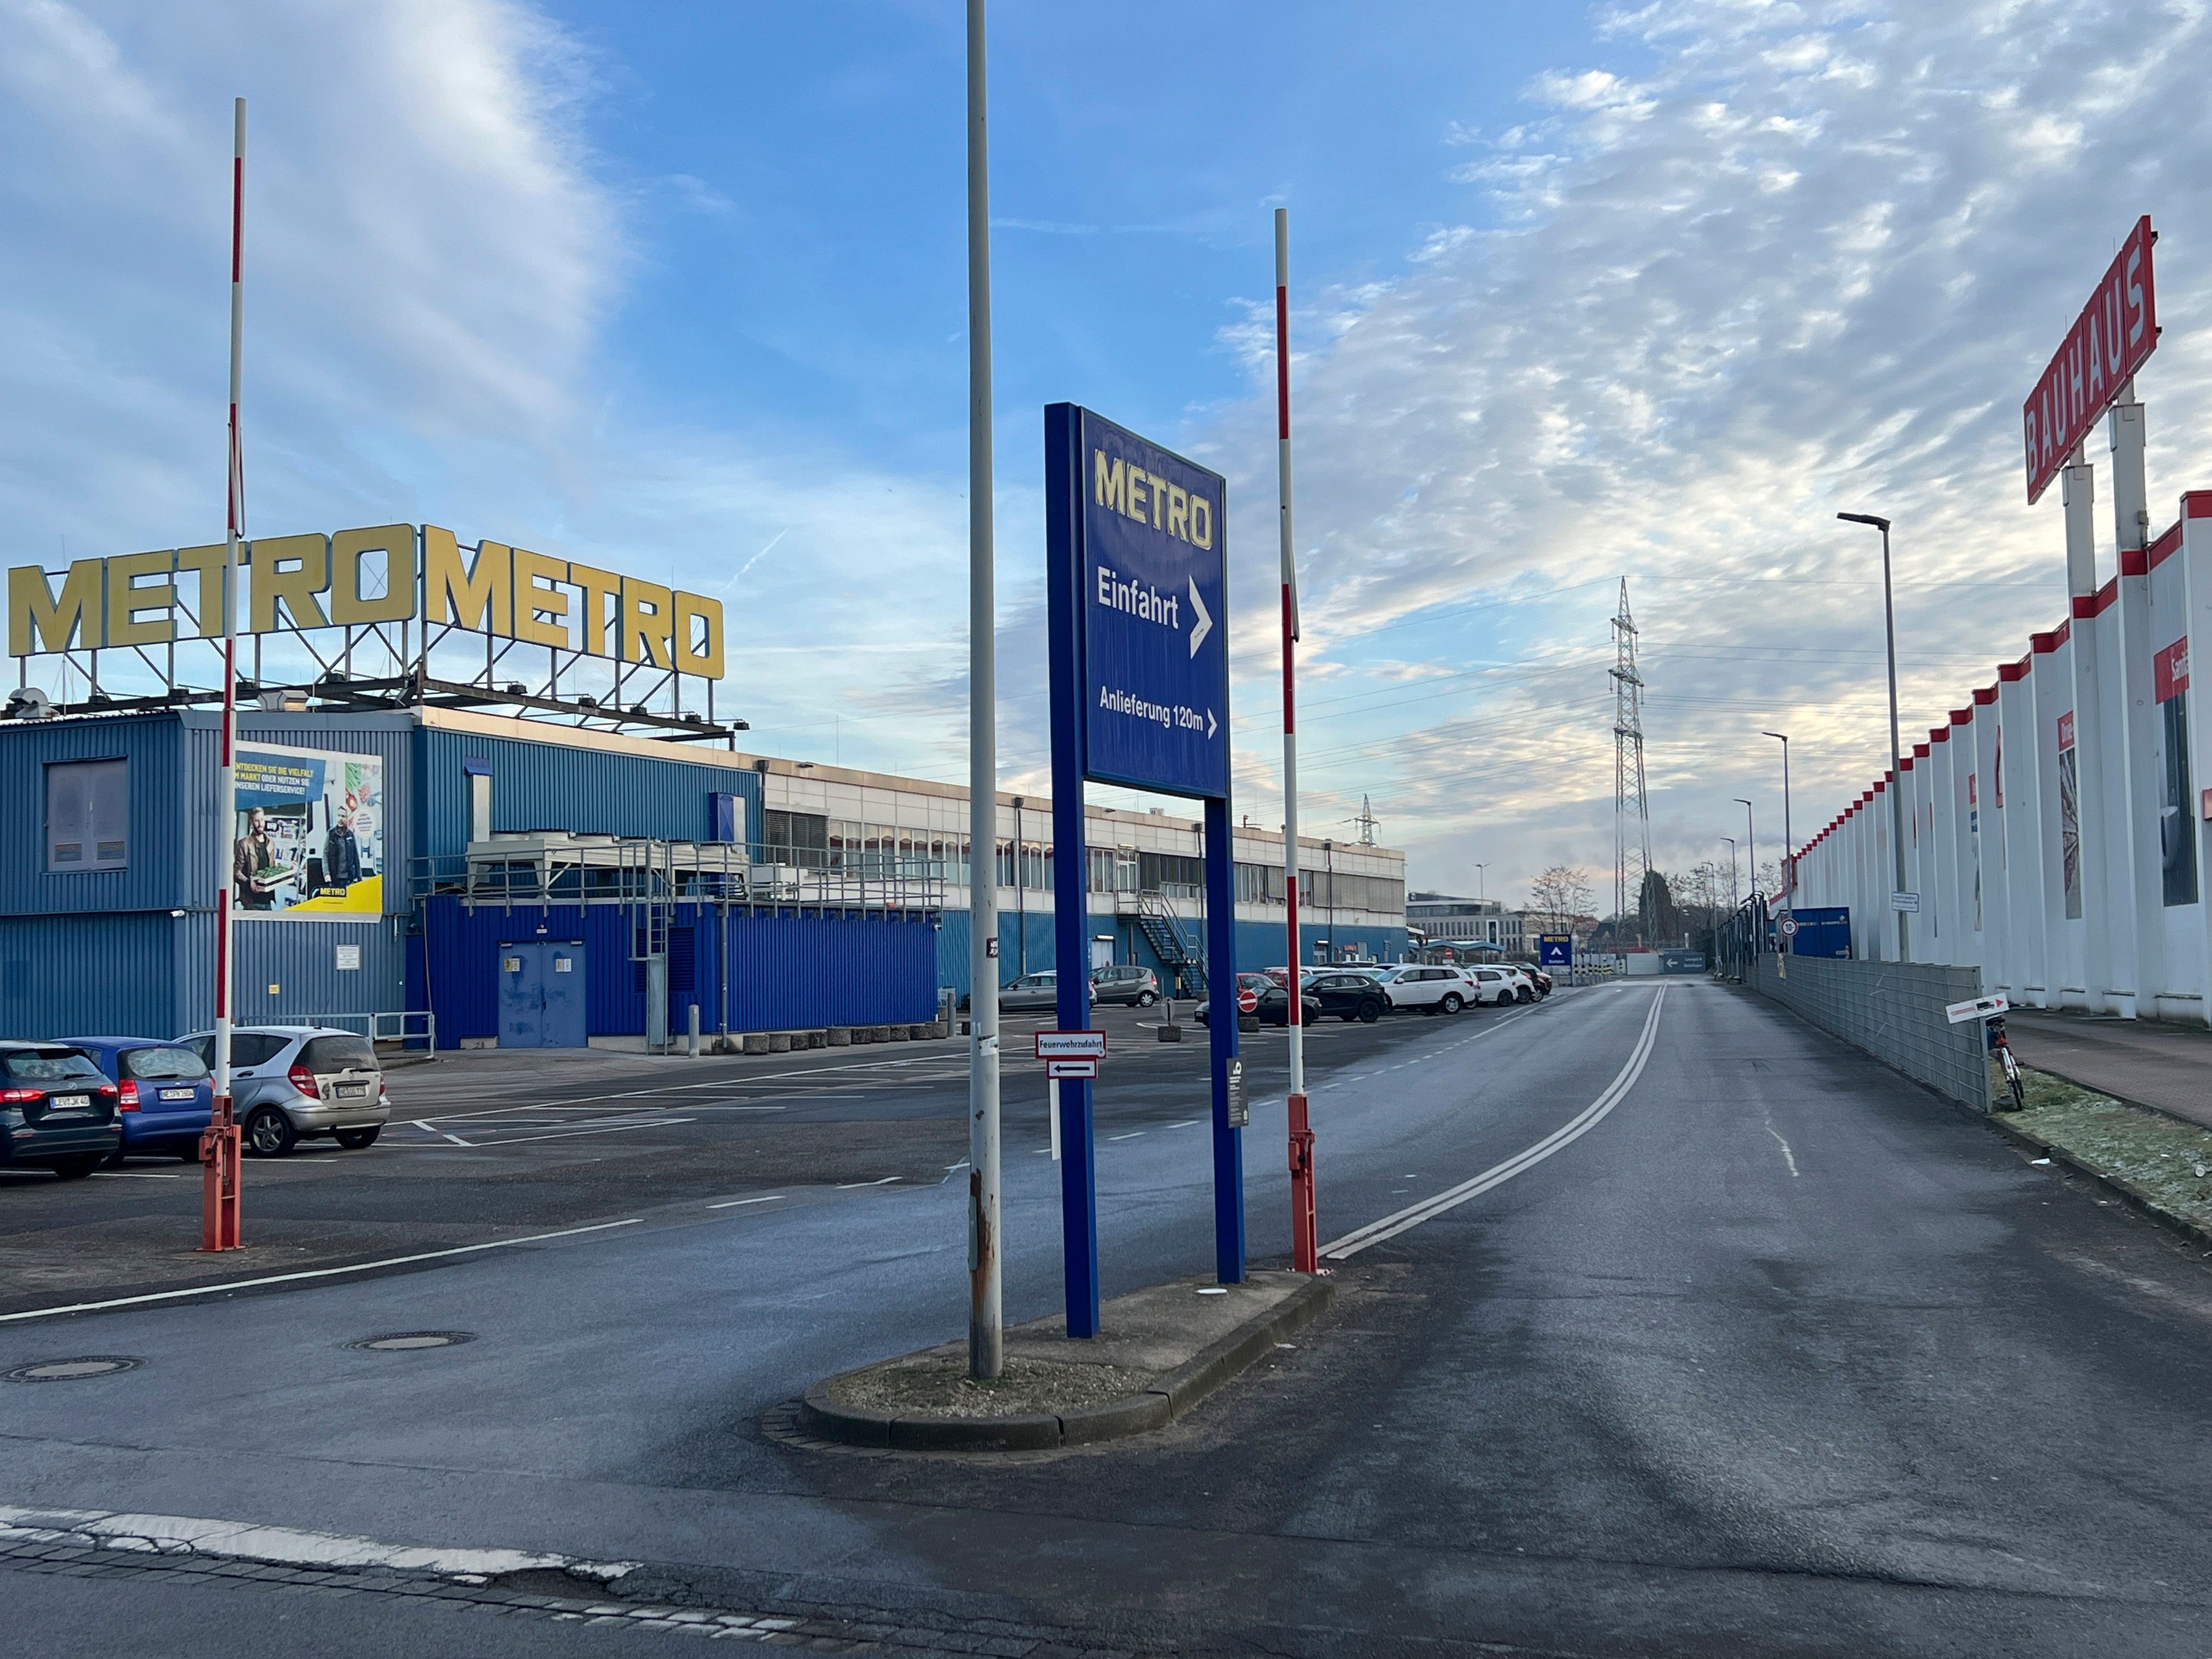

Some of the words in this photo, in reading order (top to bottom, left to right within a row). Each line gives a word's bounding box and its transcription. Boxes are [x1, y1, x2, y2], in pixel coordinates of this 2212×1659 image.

[2026, 245, 2146, 486] BAUHAUS
[1094, 448, 1213, 551] METRO
[8, 523, 418, 657] METRO
[420, 523, 725, 680] METRO
[1098, 565, 1179, 629] Einfahrt
[1099, 685, 1170, 729] Anlieferung
[1173, 702, 1204, 732] 120m
[236, 762, 267, 773] NTDECKEN
[268, 765, 278, 774] SIE
[278, 766, 288, 775] DIE
[288, 768, 314, 778] VIELFALT
[240, 772, 261, 782] MARKT
[261, 774, 276, 783] ODER
[277, 776, 300, 786] NUTZEN
[300, 778, 310, 786] SIE
[235, 781, 260, 791] NSEREN
[261, 783, 305, 795] LIEFERSERVICE!
[320, 887, 346, 896] METRO
[1039, 1039, 1102, 1049] Feuerwehrzufahrt
